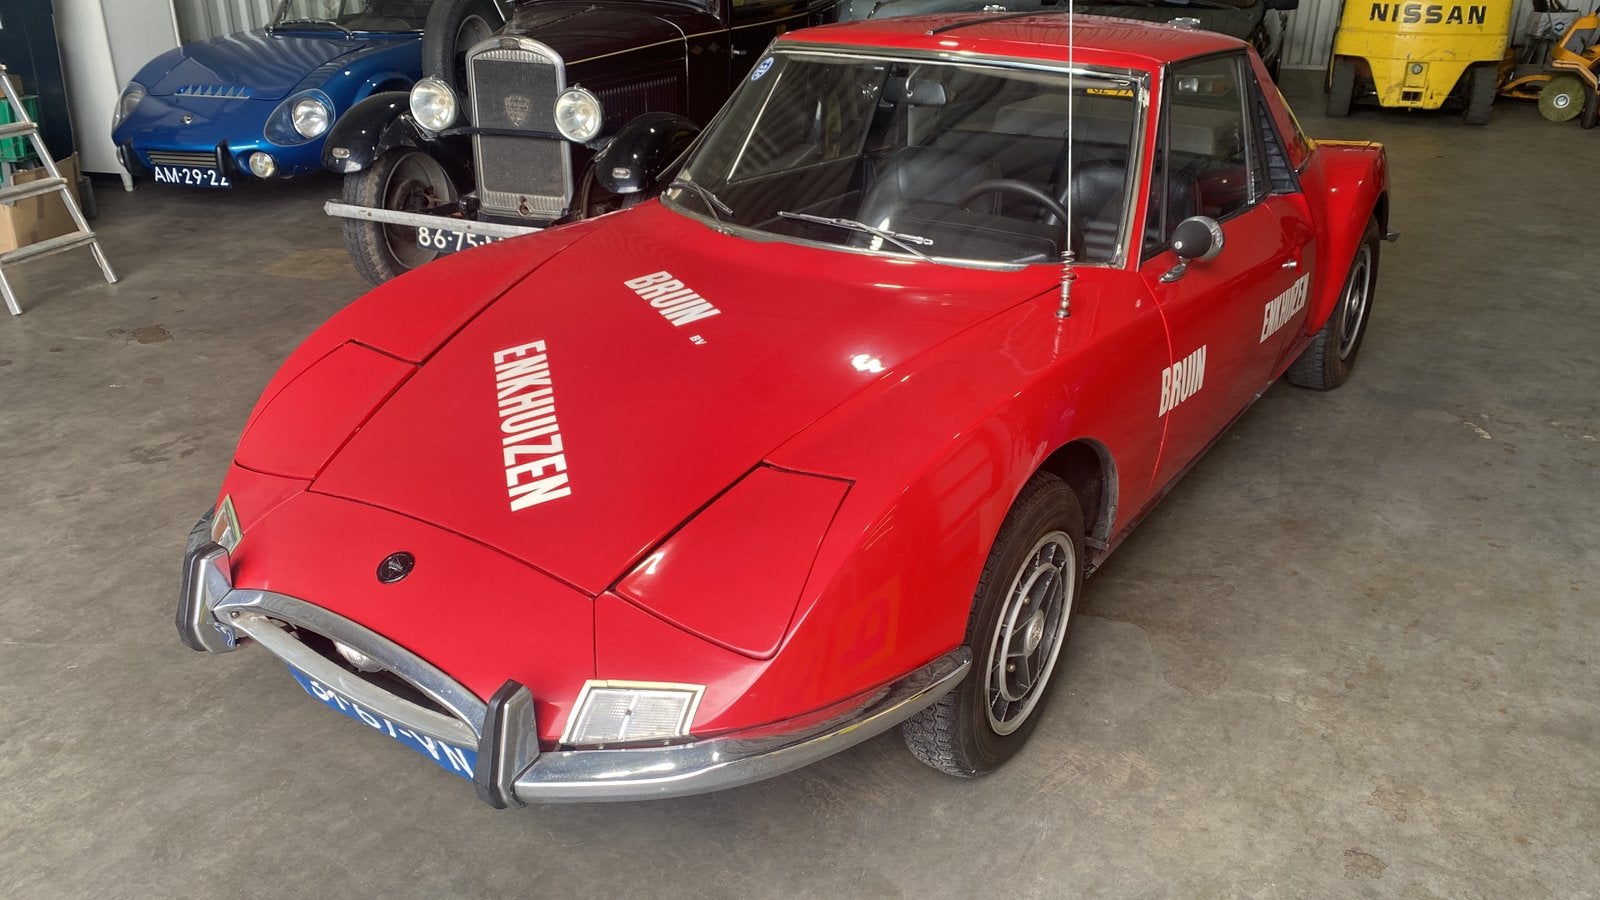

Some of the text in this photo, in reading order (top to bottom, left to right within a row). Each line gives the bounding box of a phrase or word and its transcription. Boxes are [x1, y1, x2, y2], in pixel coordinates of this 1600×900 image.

[1369, 3, 1487, 25] NISSAN
[623, 270, 722, 346] BRUIN BV
[1259, 272, 1310, 344] ENKHUIZEN
[1158, 344, 1207, 418] BRUIN
[493, 339, 572, 513] ENKHUIZEN
